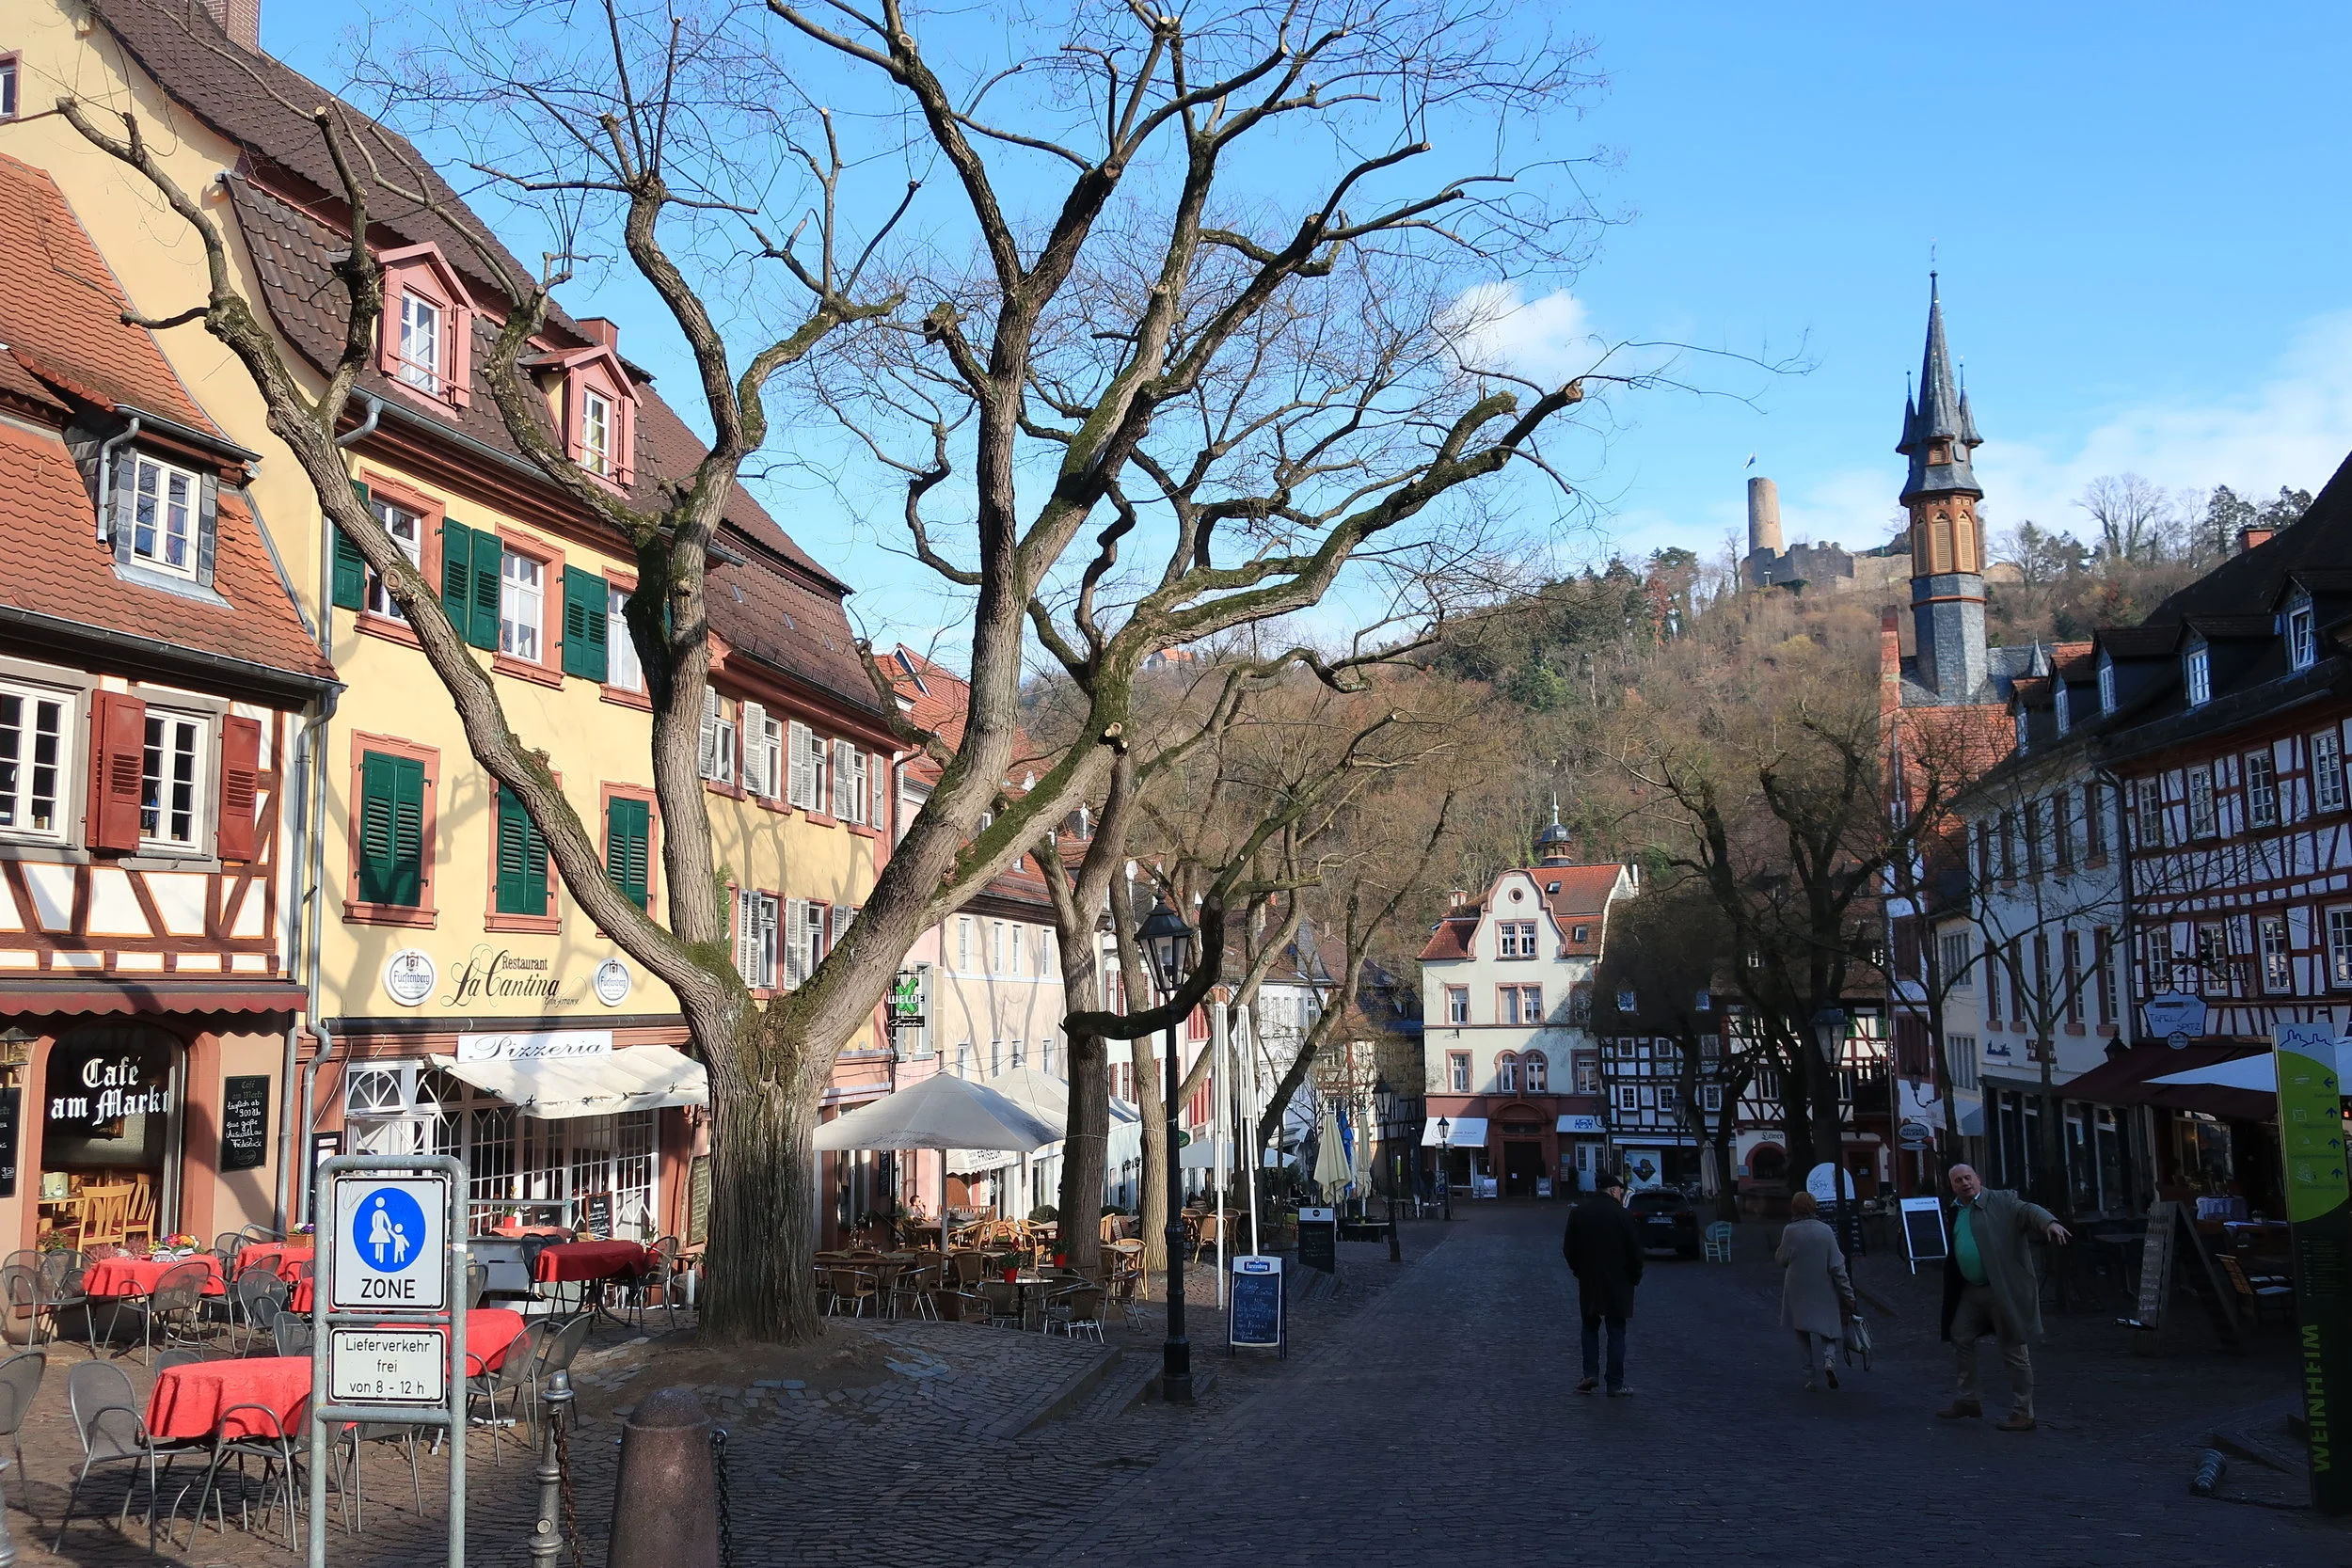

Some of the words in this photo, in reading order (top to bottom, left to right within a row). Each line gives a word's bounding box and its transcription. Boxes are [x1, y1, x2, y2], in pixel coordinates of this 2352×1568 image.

[501, 956, 548, 971] Restaurant
[445, 958, 481, 1006] La
[477, 946, 560, 1001] Cantina
[888, 994, 925, 1004] WELDE
[2175, 1022, 2201, 1031] SPITZ
[469, 1035, 604, 1061] Pizzeria
[83, 1055, 141, 1088] Café
[51, 1097, 89, 1119] am
[92, 1085, 170, 1126] Markt
[361, 1278, 416, 1299] ZONE
[345, 1338, 430, 1353] Lieferverkehr
[376, 1359, 398, 1373] frei
[349, 1382, 371, 1393] von
[376, 1380, 384, 1393] 8
[400, 1381, 412, 1394] 12
[417, 1381, 424, 1394] h
